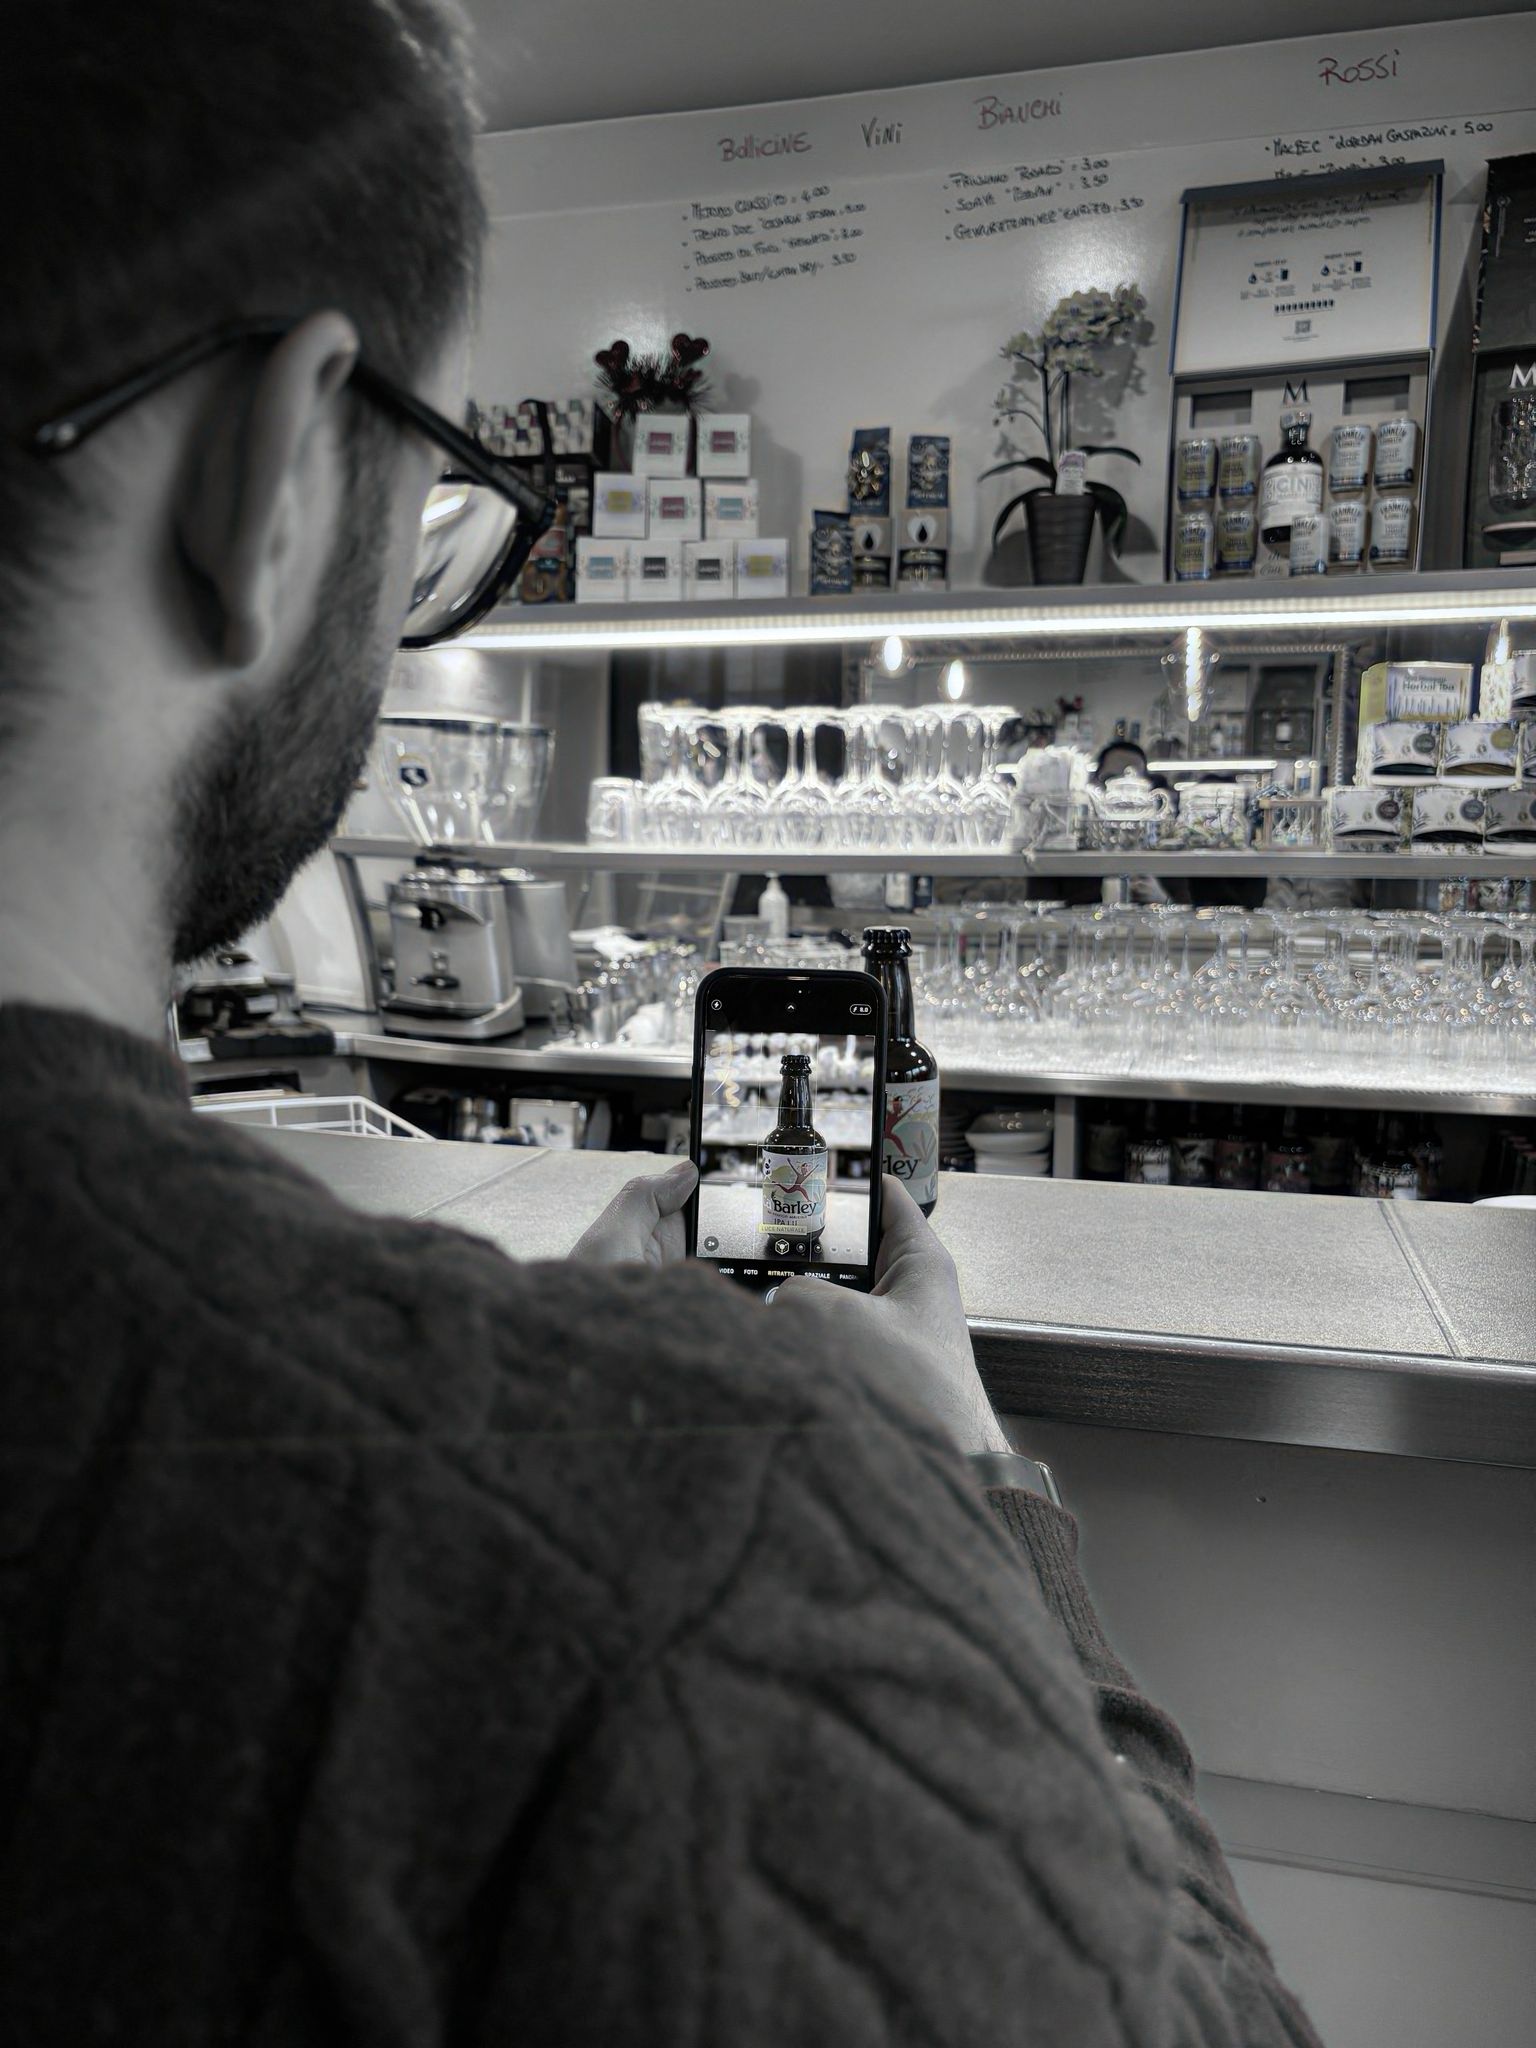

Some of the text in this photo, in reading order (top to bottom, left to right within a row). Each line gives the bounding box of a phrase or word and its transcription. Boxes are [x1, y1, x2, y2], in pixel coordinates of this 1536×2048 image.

[1283, 380, 1310, 403] M
[772, 1199, 818, 1217] Barley
[743, 1268, 759, 1276] FOTO
[767, 1269, 796, 1278] RITRATTO
